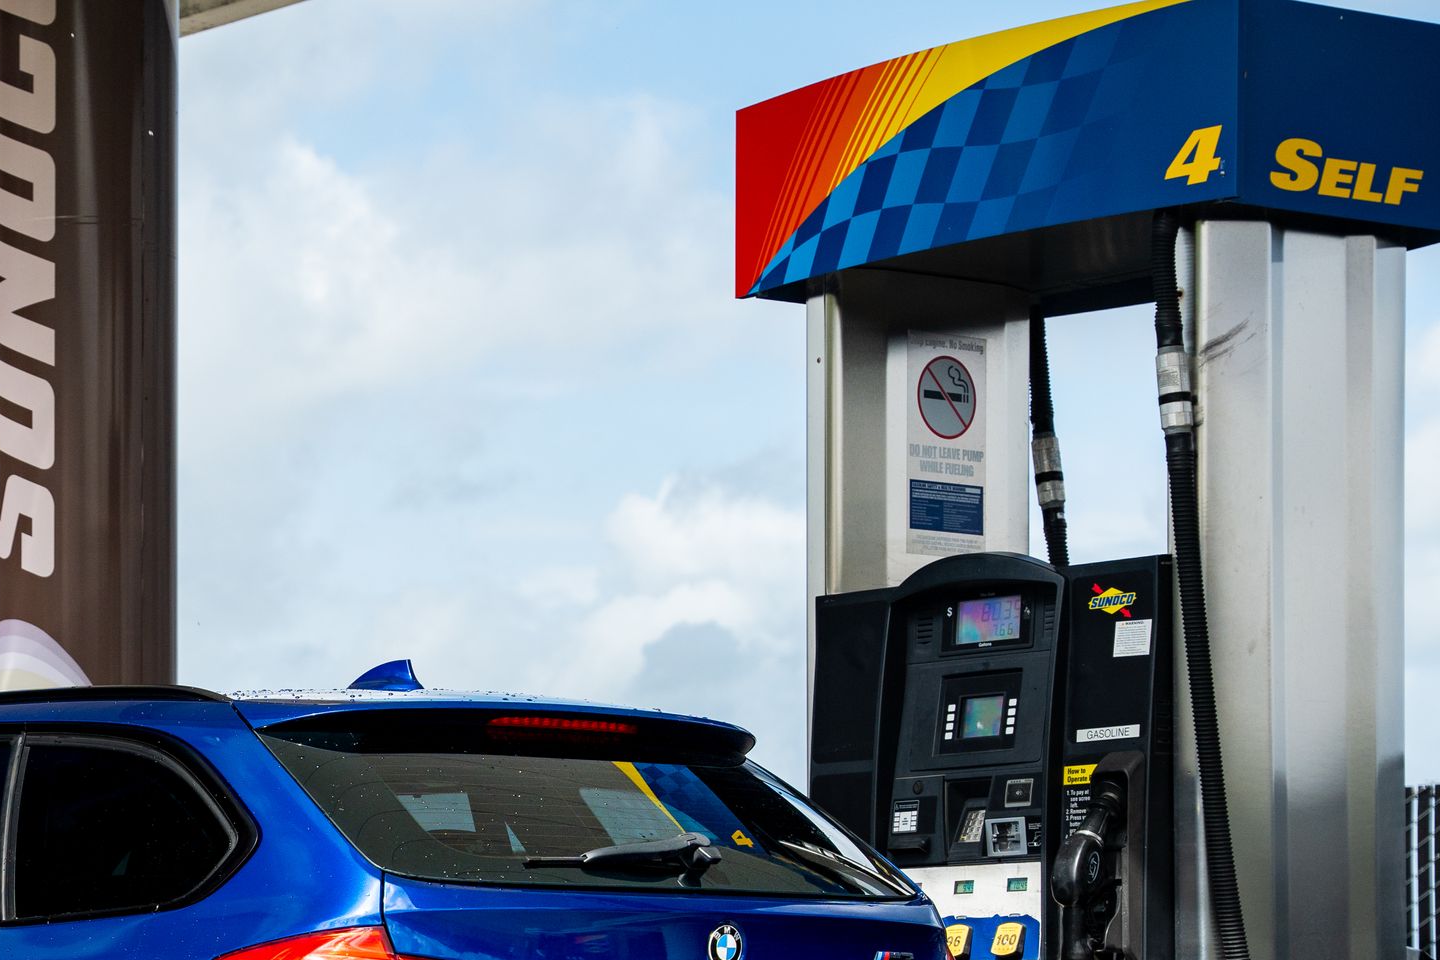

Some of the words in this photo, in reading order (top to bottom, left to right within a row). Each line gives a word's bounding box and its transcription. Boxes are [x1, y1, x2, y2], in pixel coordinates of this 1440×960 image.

[1164, 124, 1223, 186] 4
[1269, 137, 1424, 206] SELF
[958, 341, 983, 355] Smoking
[909, 443, 920, 456] DO
[922, 445, 937, 459] NOT
[939, 446, 961, 460] LEAVE
[962, 449, 984, 462] PUMP
[920, 460, 943, 473] WHILE
[945, 462, 974, 476] FUELING
[1091, 593, 1135, 609] SUNOCO
[1086, 727, 1130, 740] GASOLINE
[1067, 776, 1088, 784] Operate
[996, 934, 1017, 946] 100
